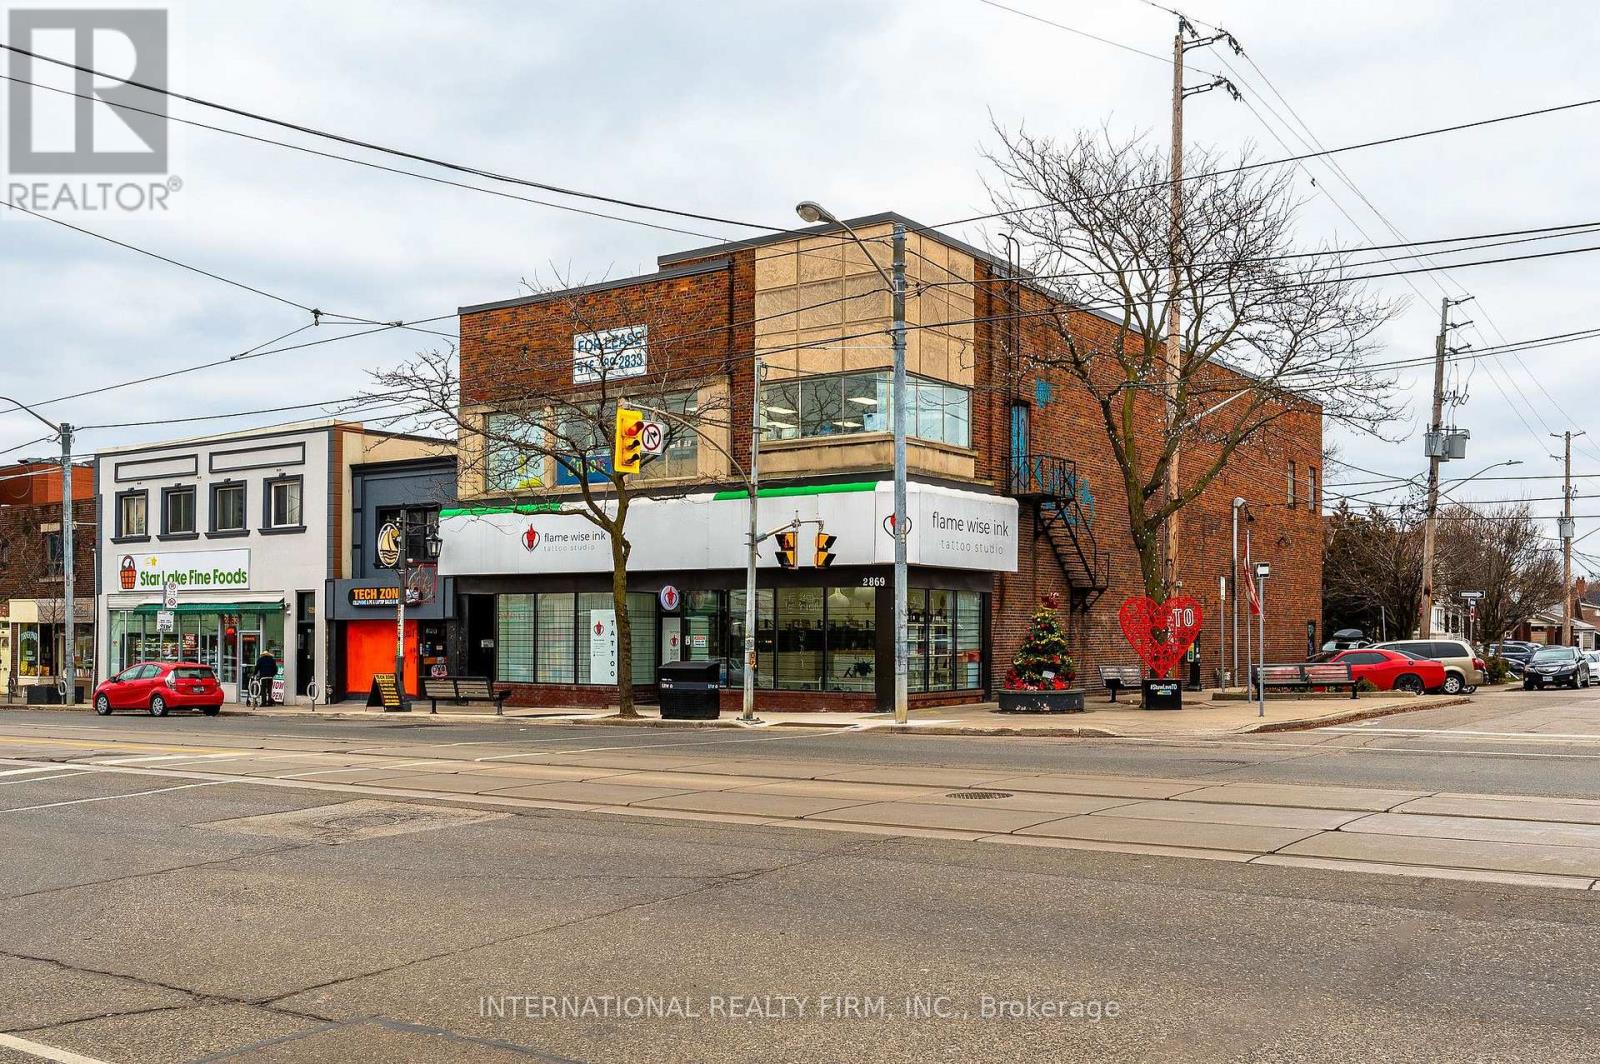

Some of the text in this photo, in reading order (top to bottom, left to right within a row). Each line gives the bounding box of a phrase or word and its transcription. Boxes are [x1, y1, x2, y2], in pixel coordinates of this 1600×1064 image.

[578, 331, 641, 352] FOR LEASE
[932, 511, 1009, 536] flame wise ink
[544, 530, 606, 542] flame wise ink
[544, 543, 595, 552] tattoo studio
[941, 540, 1004, 555] tattoo studio
[140, 568, 247, 586] Star Lake Fine Foods
[862, 577, 886, 587] 2869
[353, 589, 378, 600] TECH
[380, 587, 400, 599] ZON
[1173, 608, 1194, 627] TO
